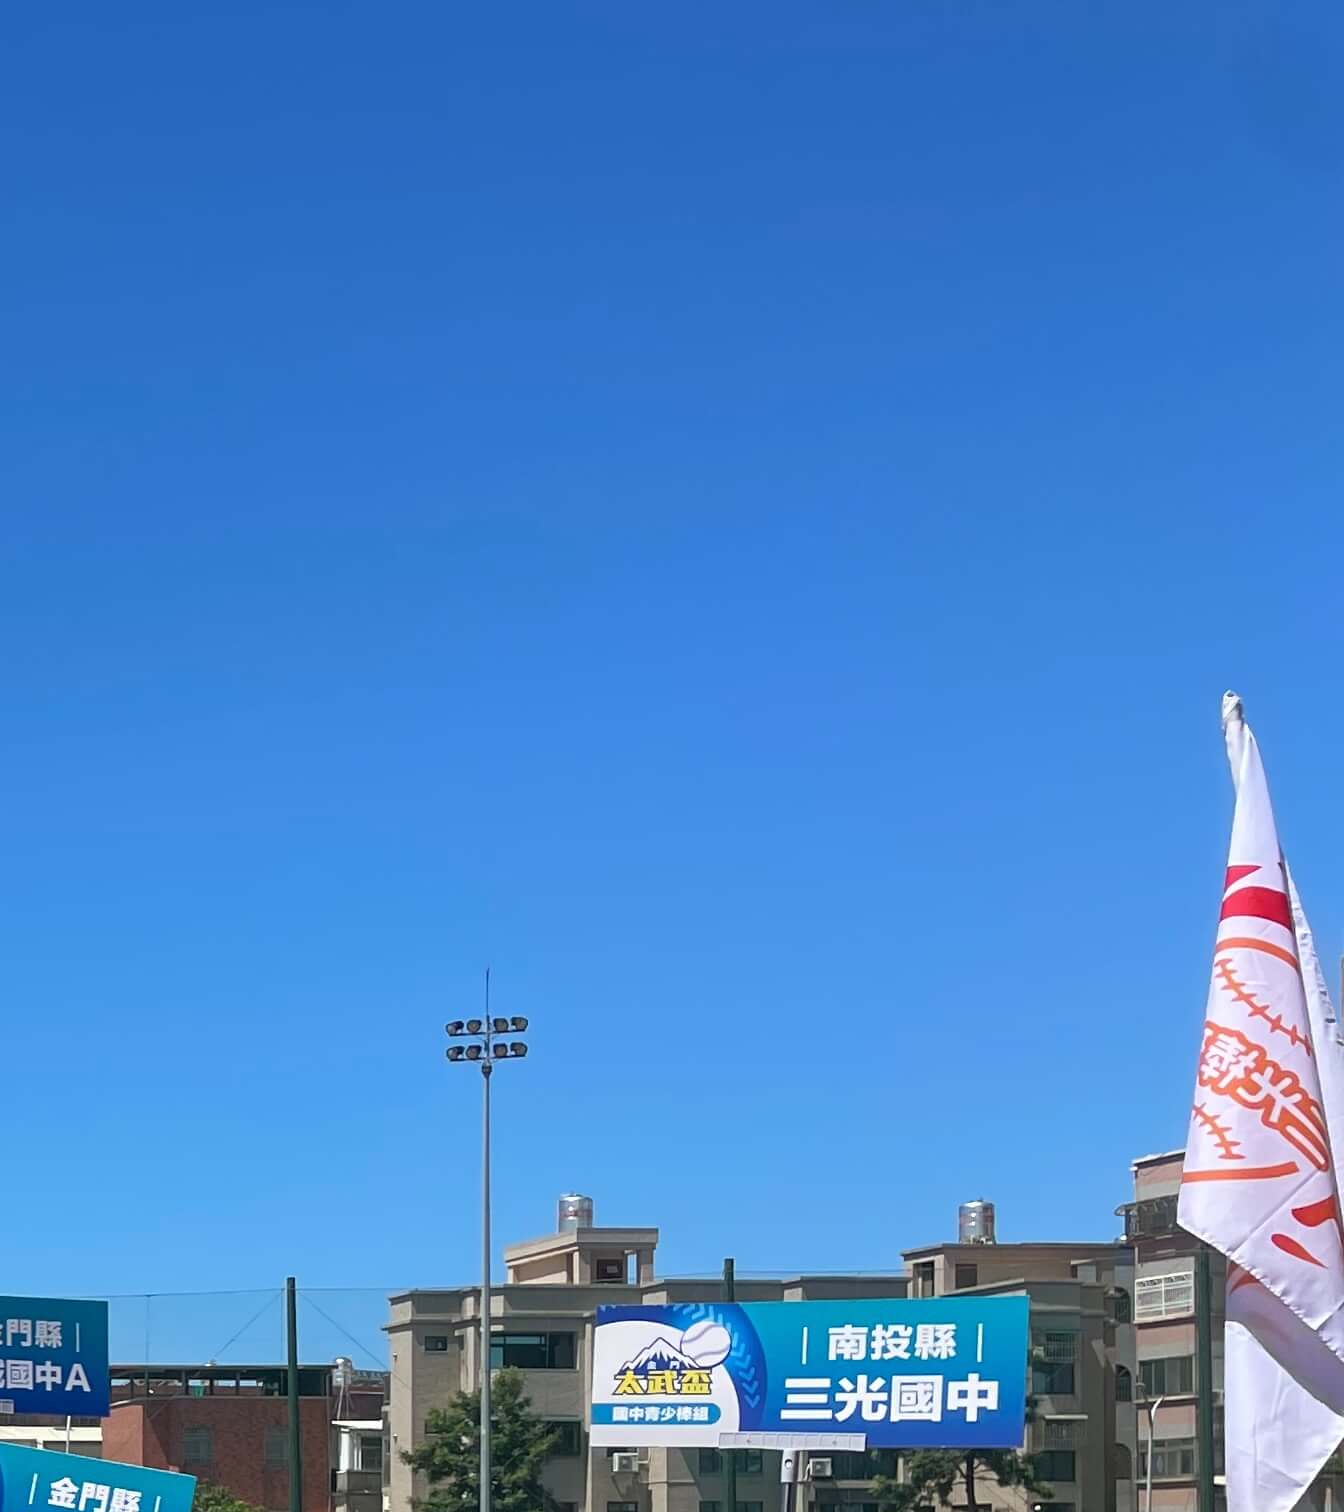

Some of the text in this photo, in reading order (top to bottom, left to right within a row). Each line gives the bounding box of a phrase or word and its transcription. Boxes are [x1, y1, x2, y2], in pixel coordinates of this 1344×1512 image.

[828, 1323, 957, 1361] 南投縣
[612, 1368, 712, 1395] 太武盃
[780, 1372, 999, 1423] 三光國中
